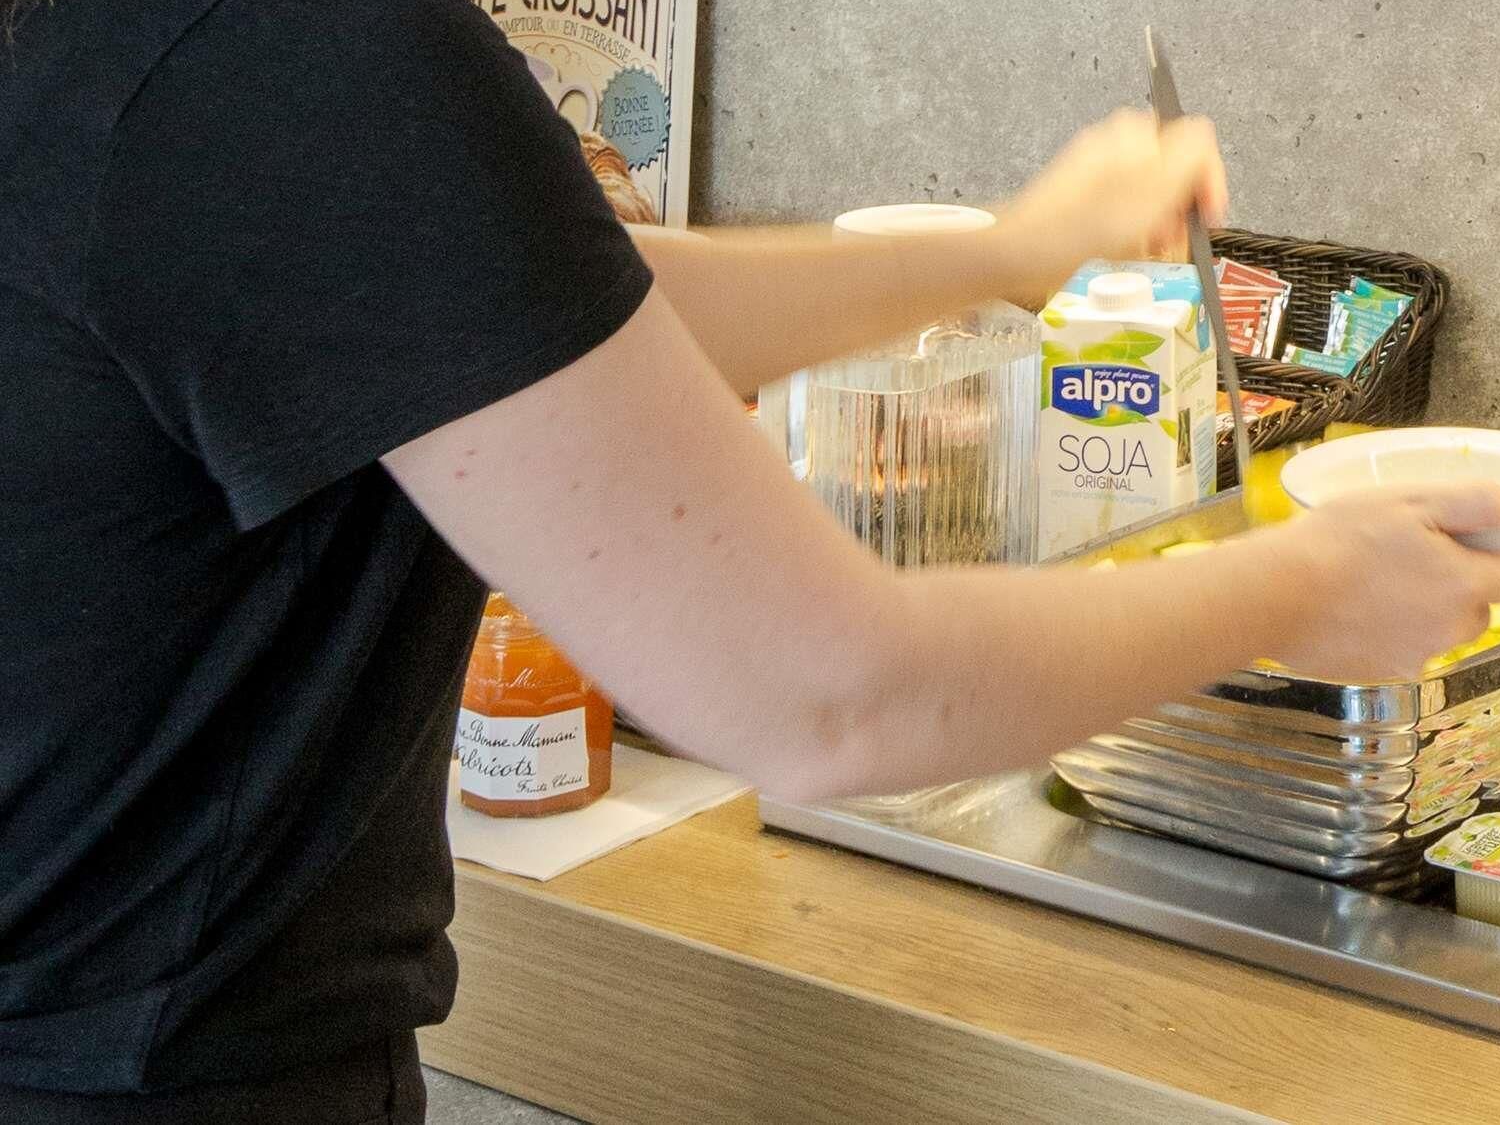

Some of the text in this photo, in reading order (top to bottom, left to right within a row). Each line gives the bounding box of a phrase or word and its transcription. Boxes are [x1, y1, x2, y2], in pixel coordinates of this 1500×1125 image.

[563, 20, 579, 37] EN
[580, 24, 632, 64] TERRASSE
[1060, 368, 1153, 411] alpro
[1057, 434, 1153, 478] SOJA
[1073, 474, 1135, 492] ORIGINAL
[470, 718, 510, 748] Bonne
[513, 723, 577, 748] Maman
